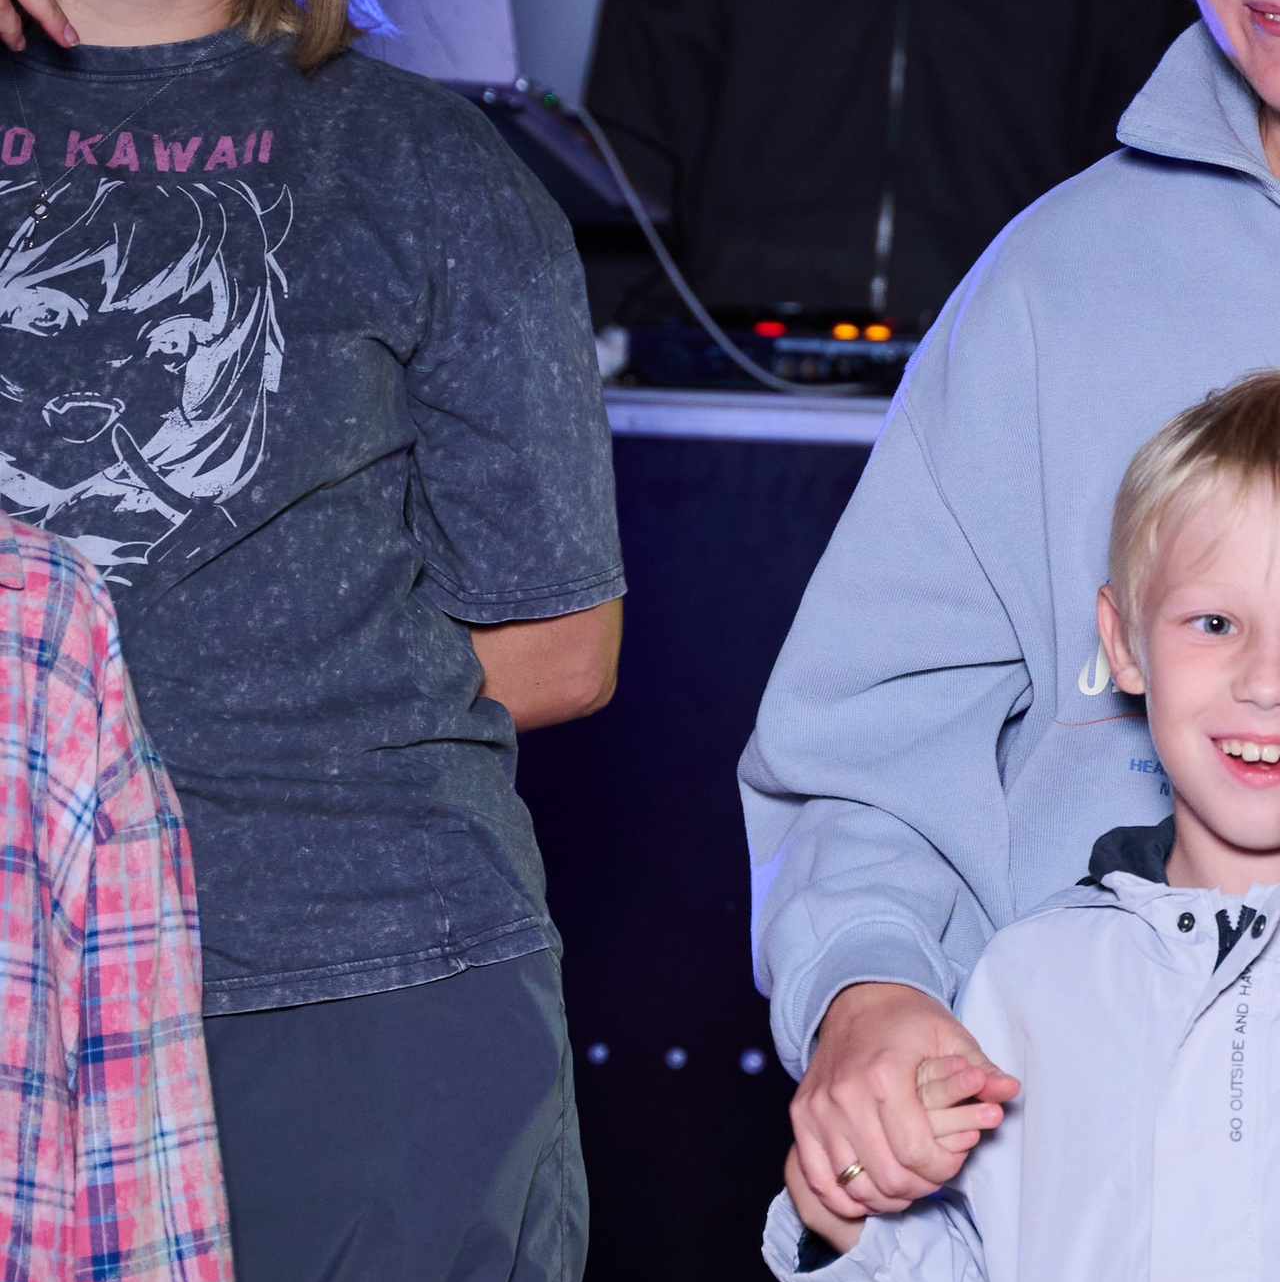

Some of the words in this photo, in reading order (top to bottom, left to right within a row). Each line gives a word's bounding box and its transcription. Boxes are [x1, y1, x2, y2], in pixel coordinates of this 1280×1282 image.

[0, 126, 35, 166] O
[64, 129, 274, 172] KAWAII
[1130, 757, 1166, 776] HEA
[1239, 966, 1252, 996] HAV
[1234, 1003, 1249, 1034] AND
[1230, 1040, 1245, 1111] OUTSIDE
[1230, 1118, 1243, 1142] GO
